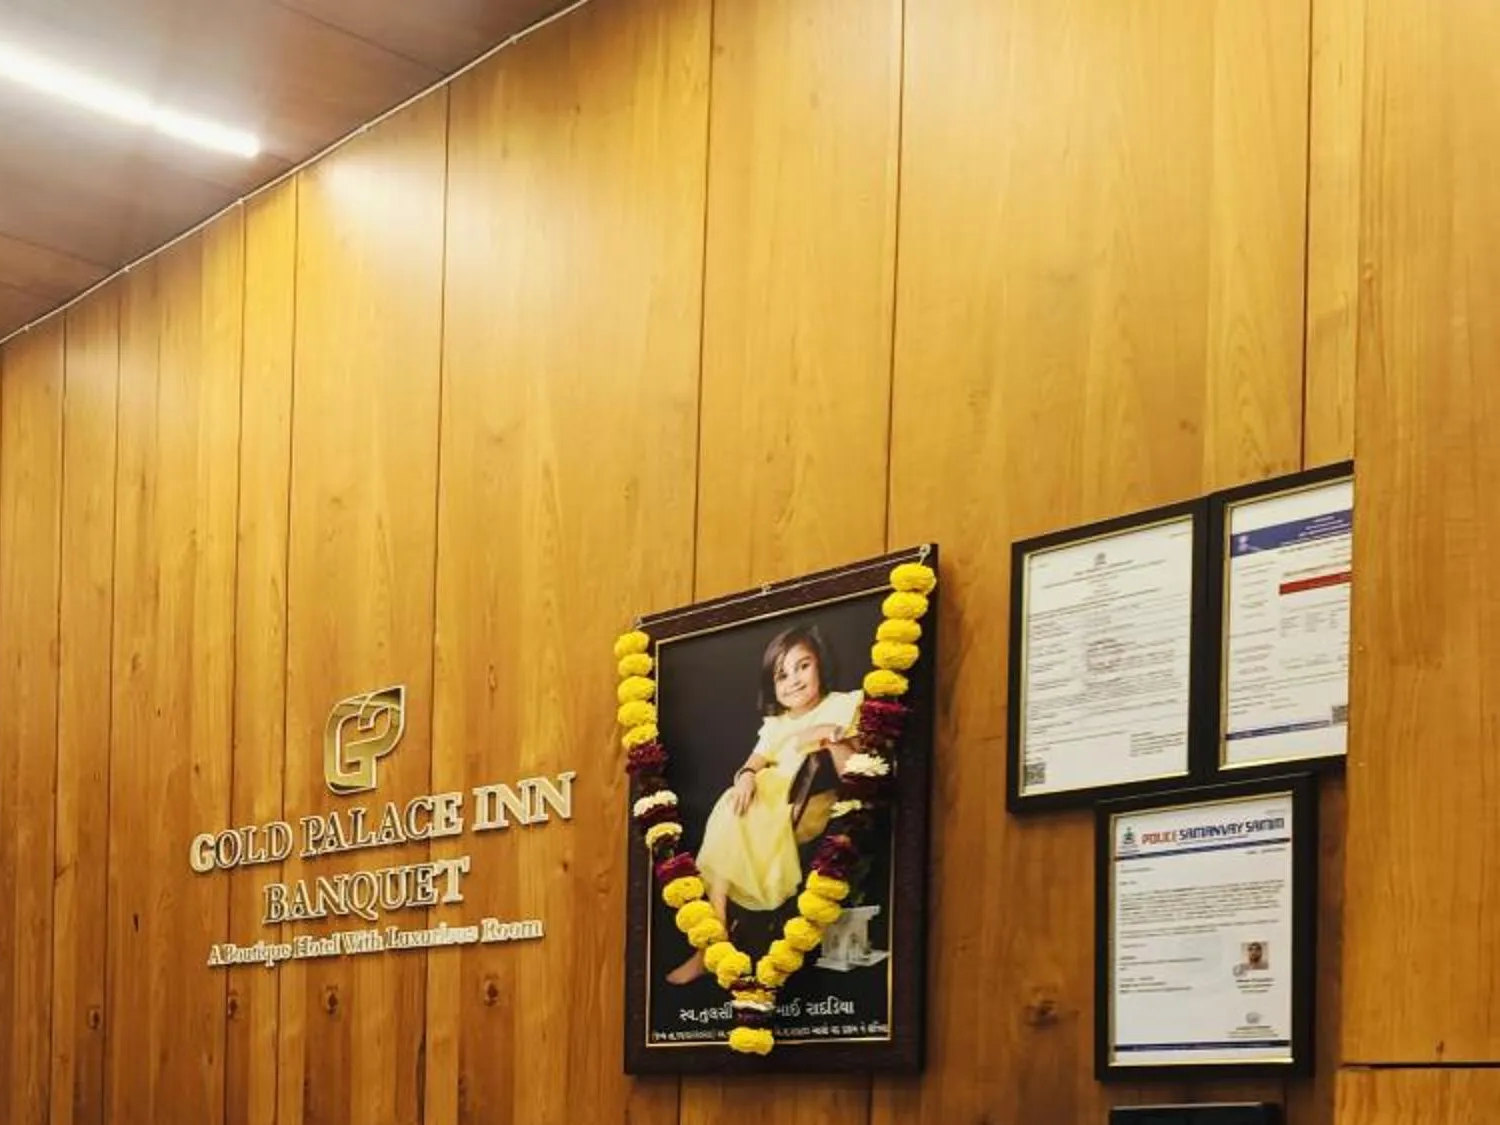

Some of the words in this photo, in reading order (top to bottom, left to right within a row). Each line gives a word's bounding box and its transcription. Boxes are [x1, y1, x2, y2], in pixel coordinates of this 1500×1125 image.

[189, 820, 294, 873] GOLD
[299, 790, 464, 858] PALACE
[471, 770, 577, 833] INN
[1141, 829, 1177, 845] POLICE
[262, 856, 471, 924] BANQUET
[207, 943, 228, 966] A
[225, 938, 293, 968] Boutique
[293, 931, 342, 959] Hotel
[341, 927, 385, 954] With
[480, 917, 545, 943] Room
